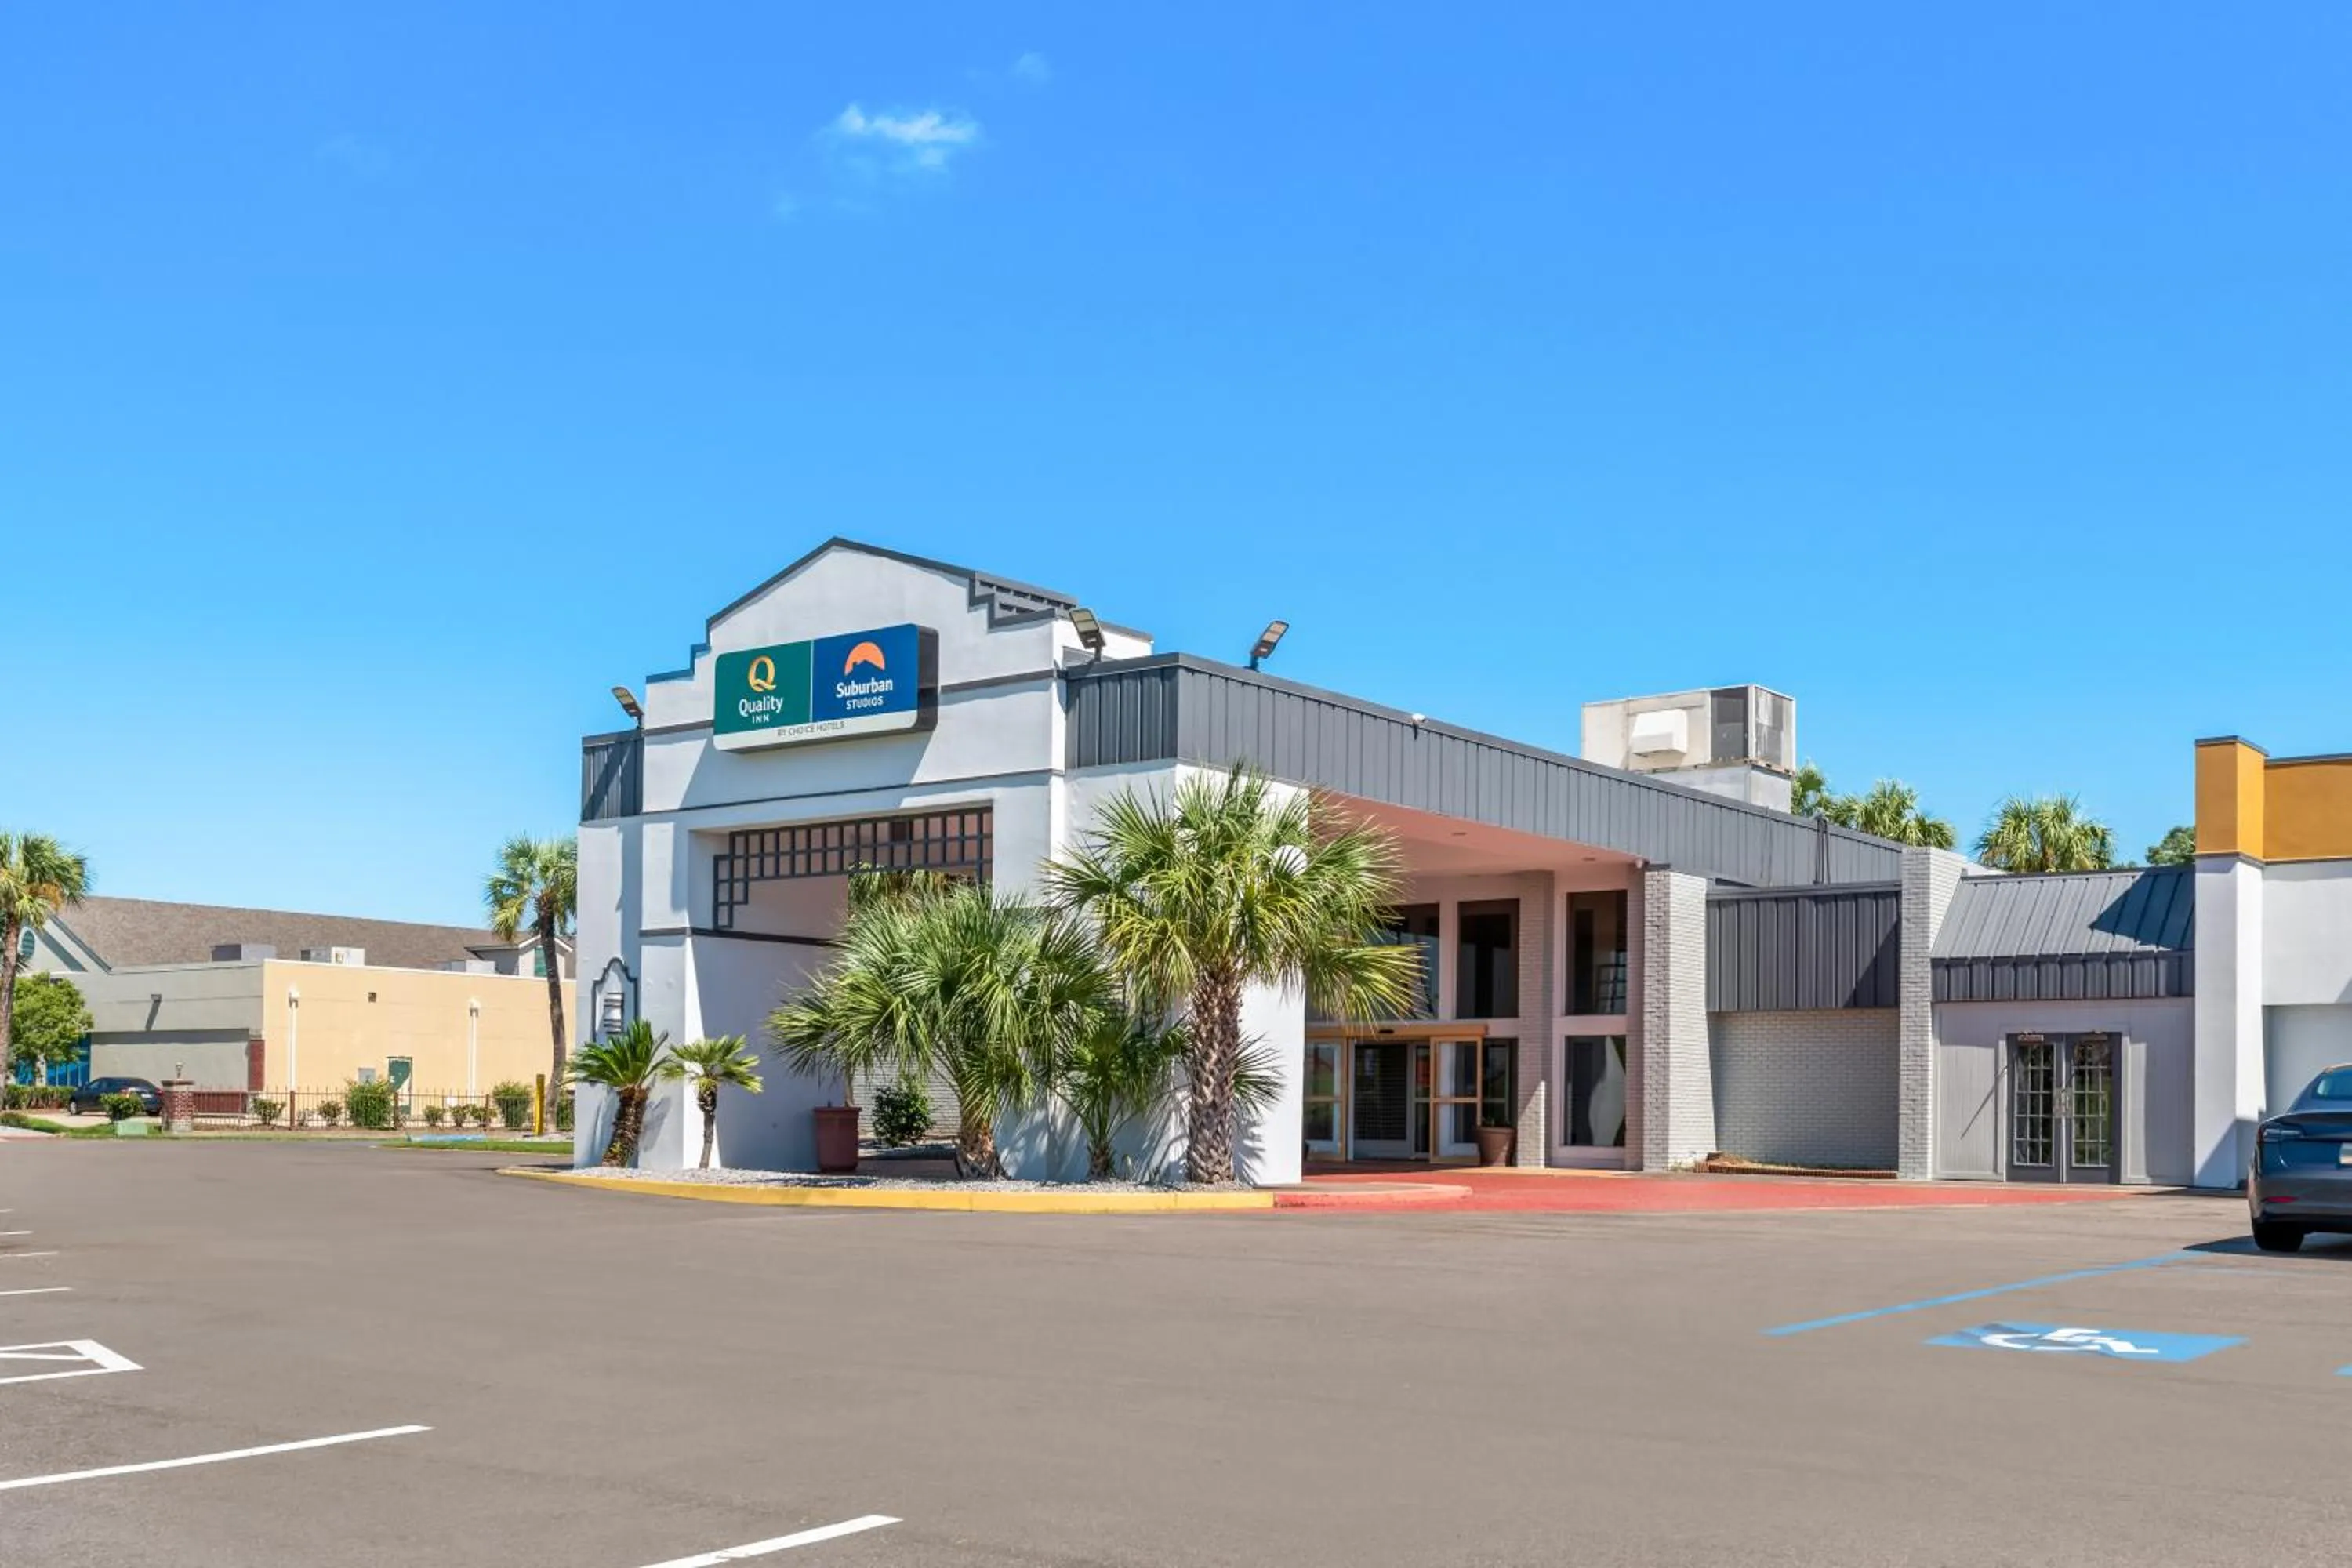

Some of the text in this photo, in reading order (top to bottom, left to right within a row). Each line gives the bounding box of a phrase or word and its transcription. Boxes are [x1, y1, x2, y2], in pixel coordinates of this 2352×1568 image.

[748, 655, 777, 691] Q
[836, 677, 893, 698] Suburban
[739, 695, 783, 717] Quality
[846, 696, 884, 710] STUDIOS
[752, 714, 770, 724] INN
